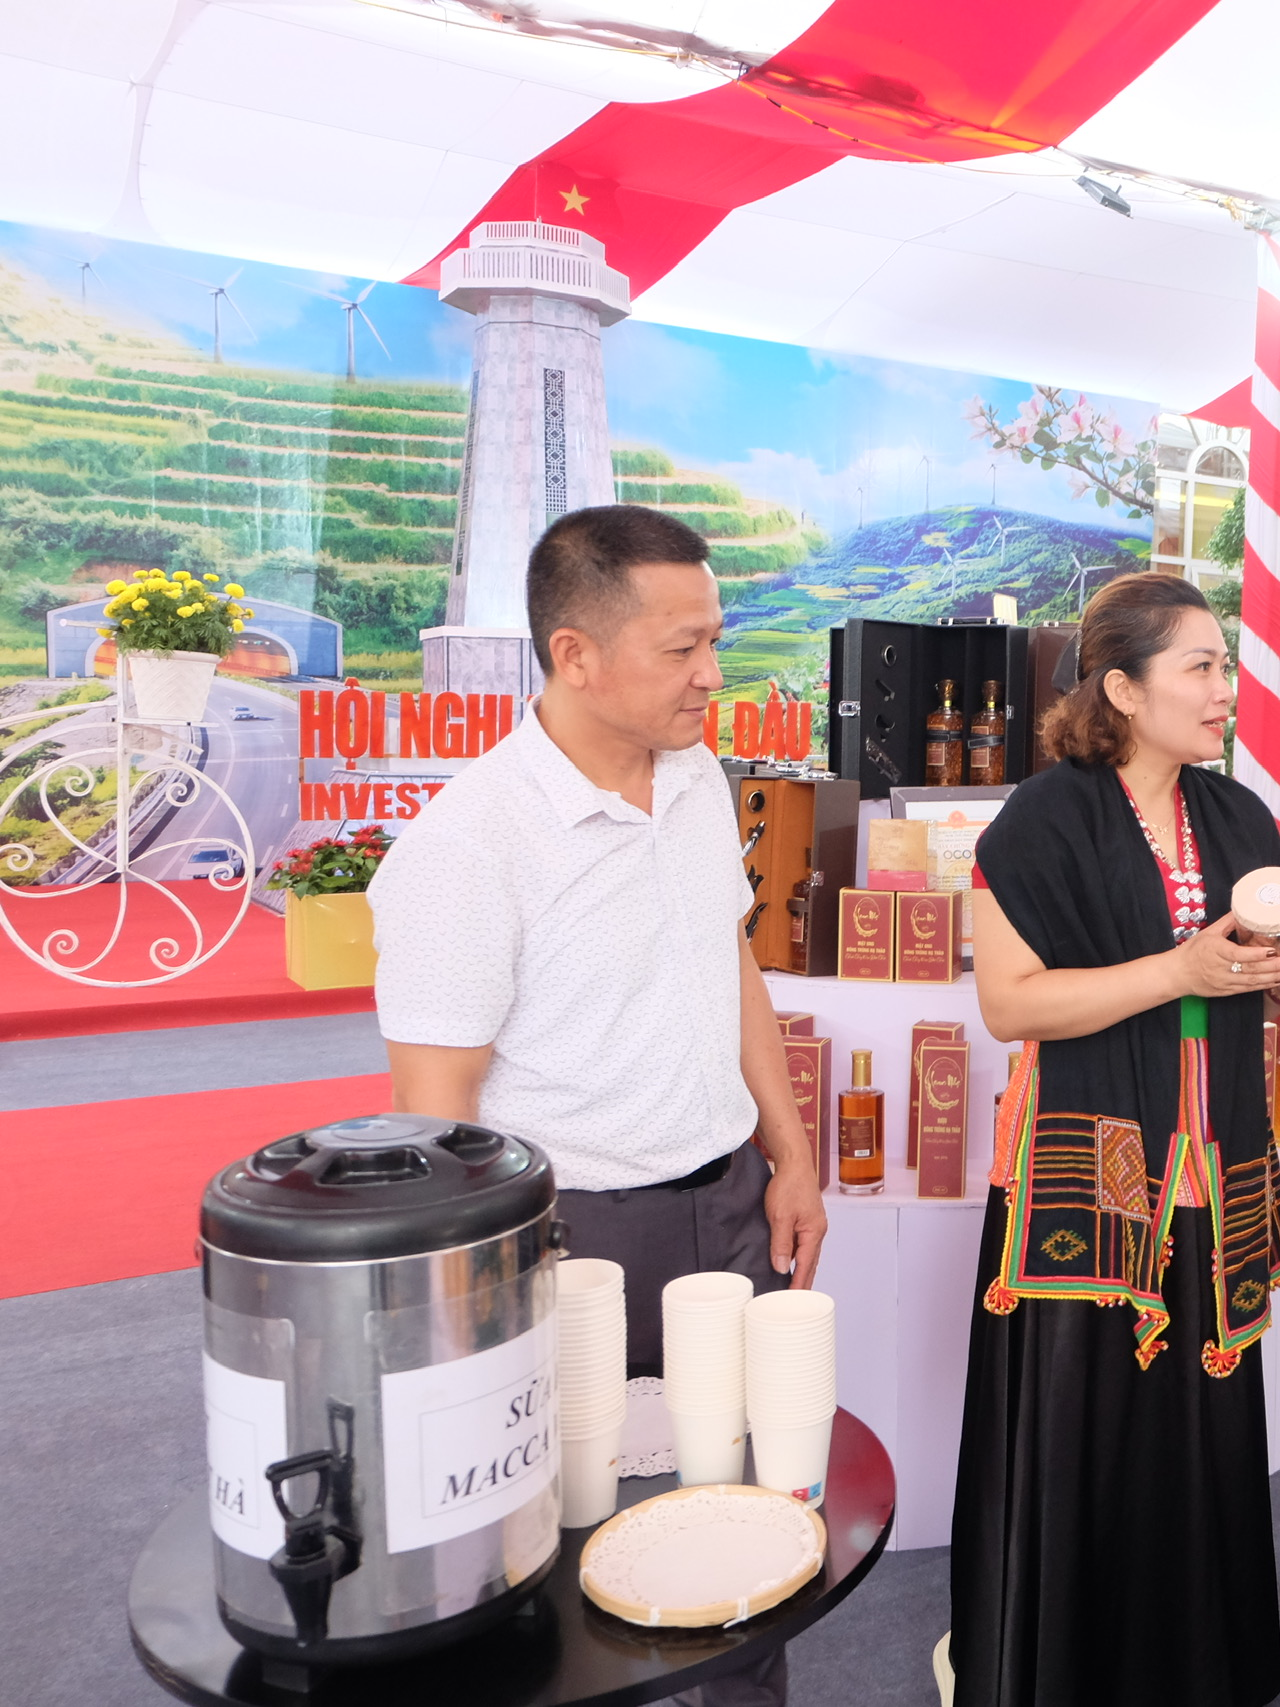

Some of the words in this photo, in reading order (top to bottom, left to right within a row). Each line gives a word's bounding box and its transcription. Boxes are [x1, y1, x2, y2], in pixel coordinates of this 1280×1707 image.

[299, 676, 386, 770] HỘI
[732, 681, 812, 761] ĐẦU
[943, 849, 972, 860] OCO
[216, 1477, 245, 1515] HÀ
[440, 1423, 550, 1505] MACCA
